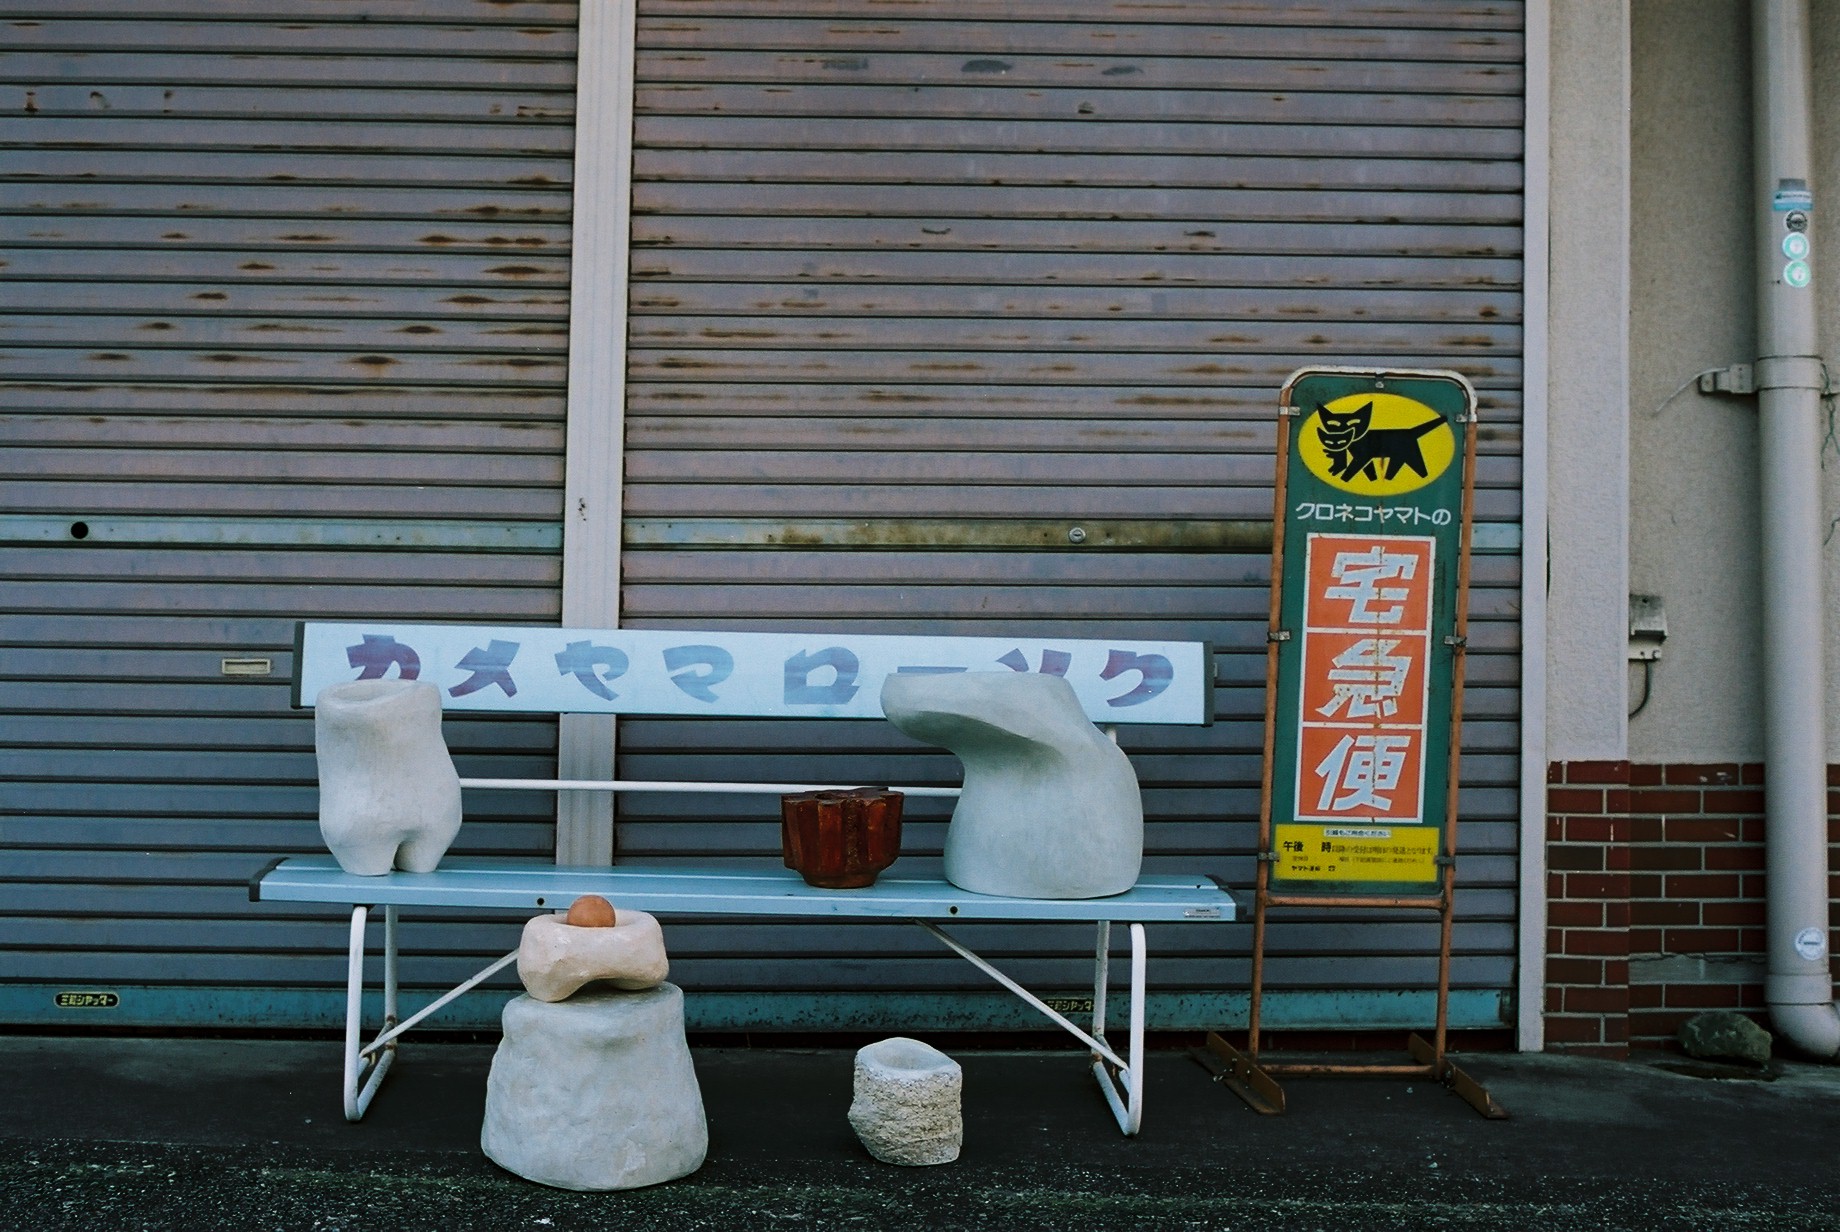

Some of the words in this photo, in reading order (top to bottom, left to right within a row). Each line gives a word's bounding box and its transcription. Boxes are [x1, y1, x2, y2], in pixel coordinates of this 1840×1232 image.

[1295, 501, 1452, 526] クロネコヤマトの
[1315, 546, 1420, 813] 宅急便
[1283, 841, 1303, 852] 午後
